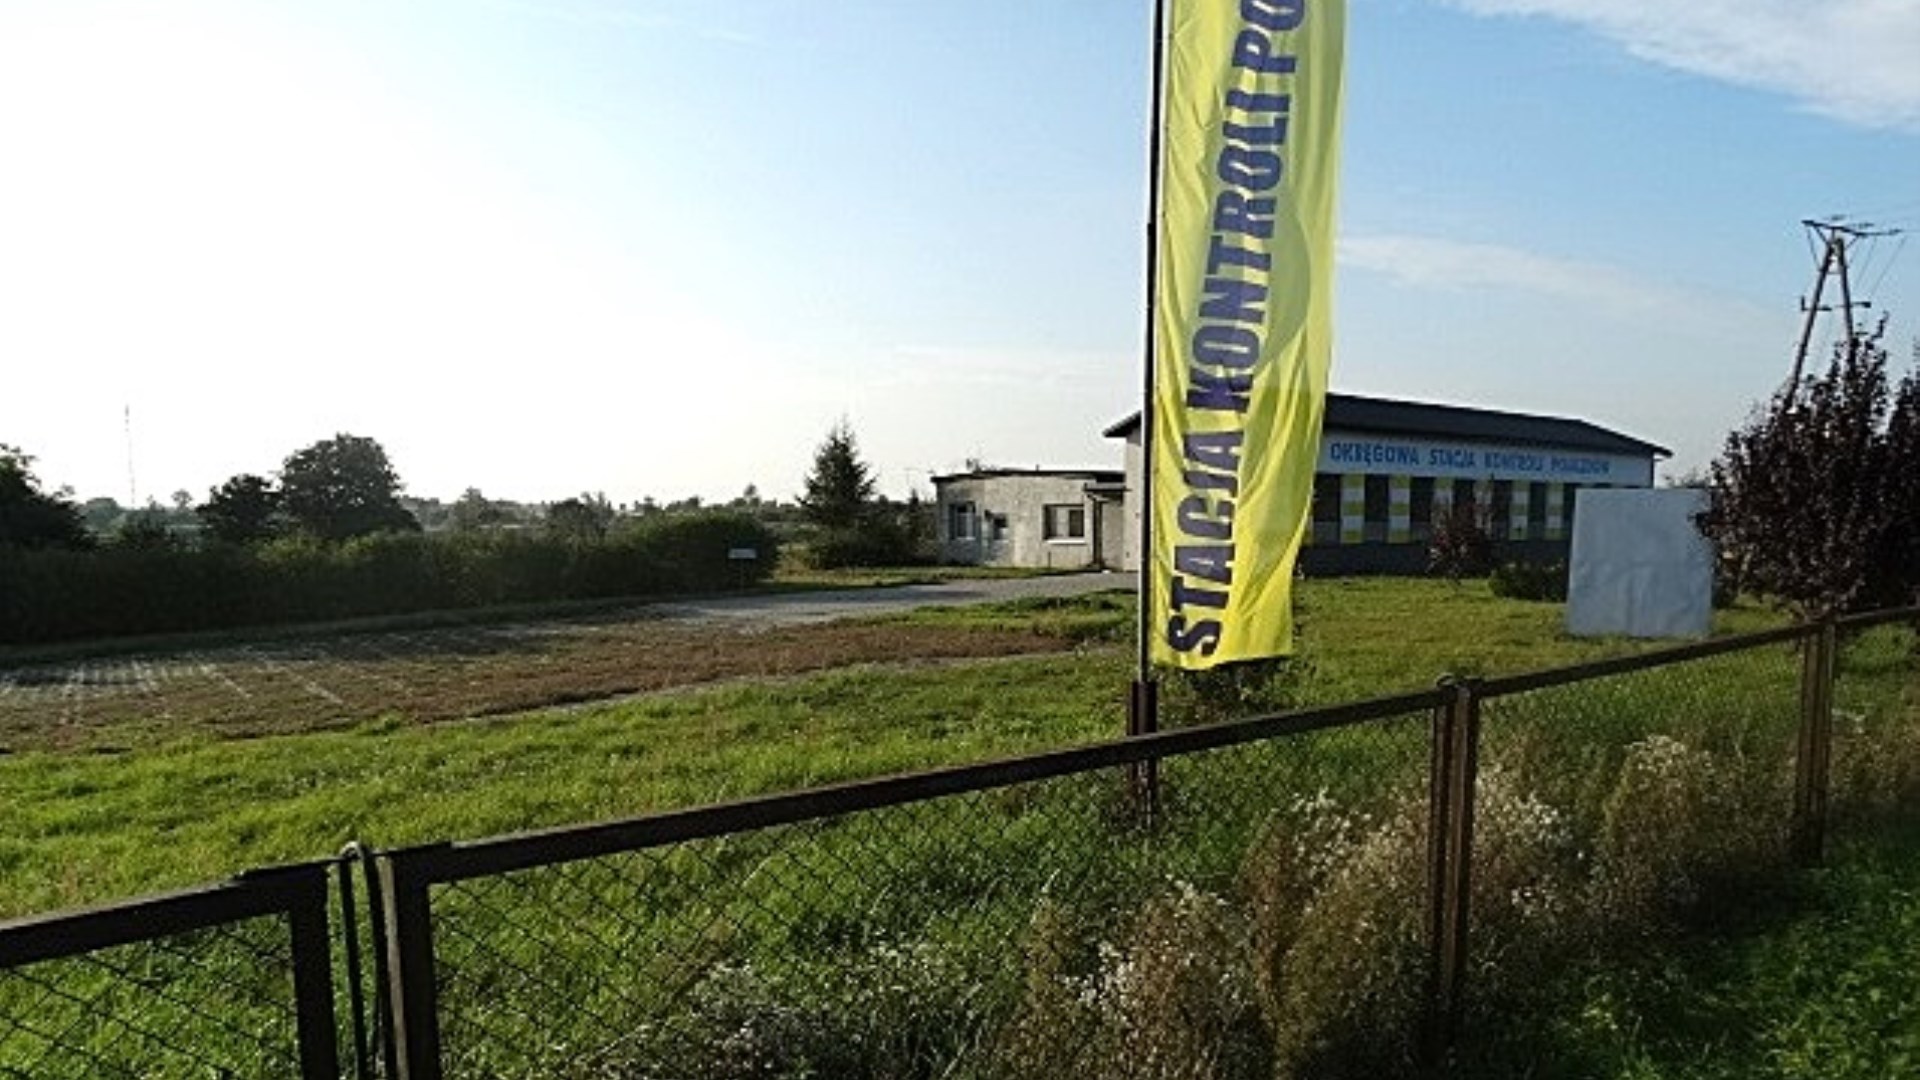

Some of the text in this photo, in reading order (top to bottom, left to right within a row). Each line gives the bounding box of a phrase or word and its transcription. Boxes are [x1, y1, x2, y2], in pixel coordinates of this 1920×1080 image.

[1186, 89, 1290, 414] KONTROLI
[1168, 431, 1244, 656] STACJA
[1331, 443, 1419, 467] OKRĘGOWA
